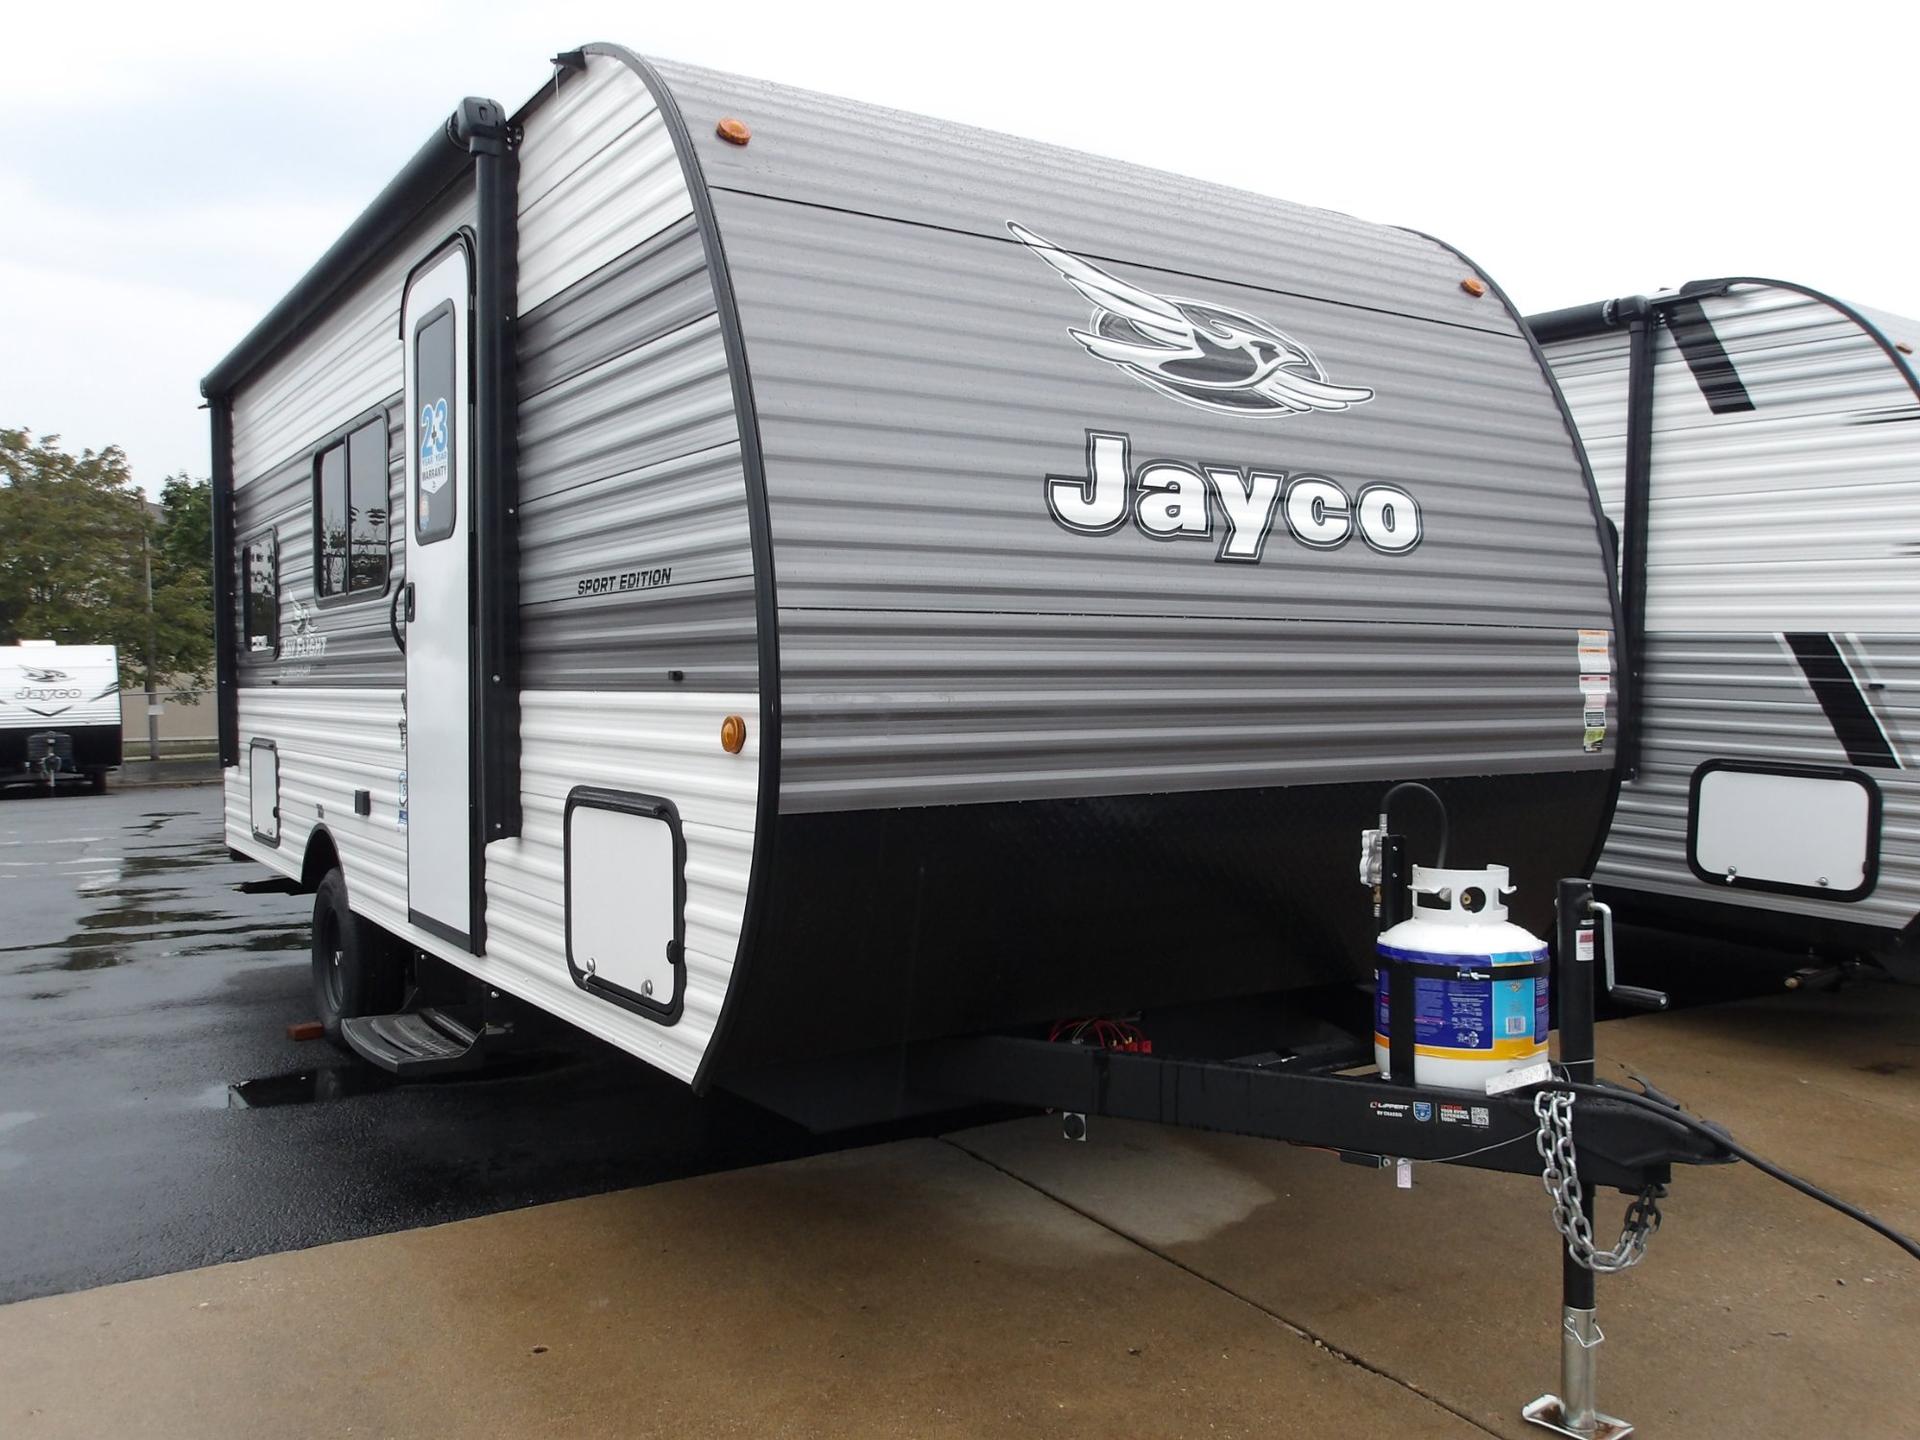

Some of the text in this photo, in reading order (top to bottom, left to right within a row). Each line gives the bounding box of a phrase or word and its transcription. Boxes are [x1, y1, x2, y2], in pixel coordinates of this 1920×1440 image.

[1045, 428, 1423, 564] Jayco
[578, 568, 672, 595] SPORT EDITION
[15, 687, 81, 701] Jayco
[1378, 1102, 1410, 1110] LIPPERT
